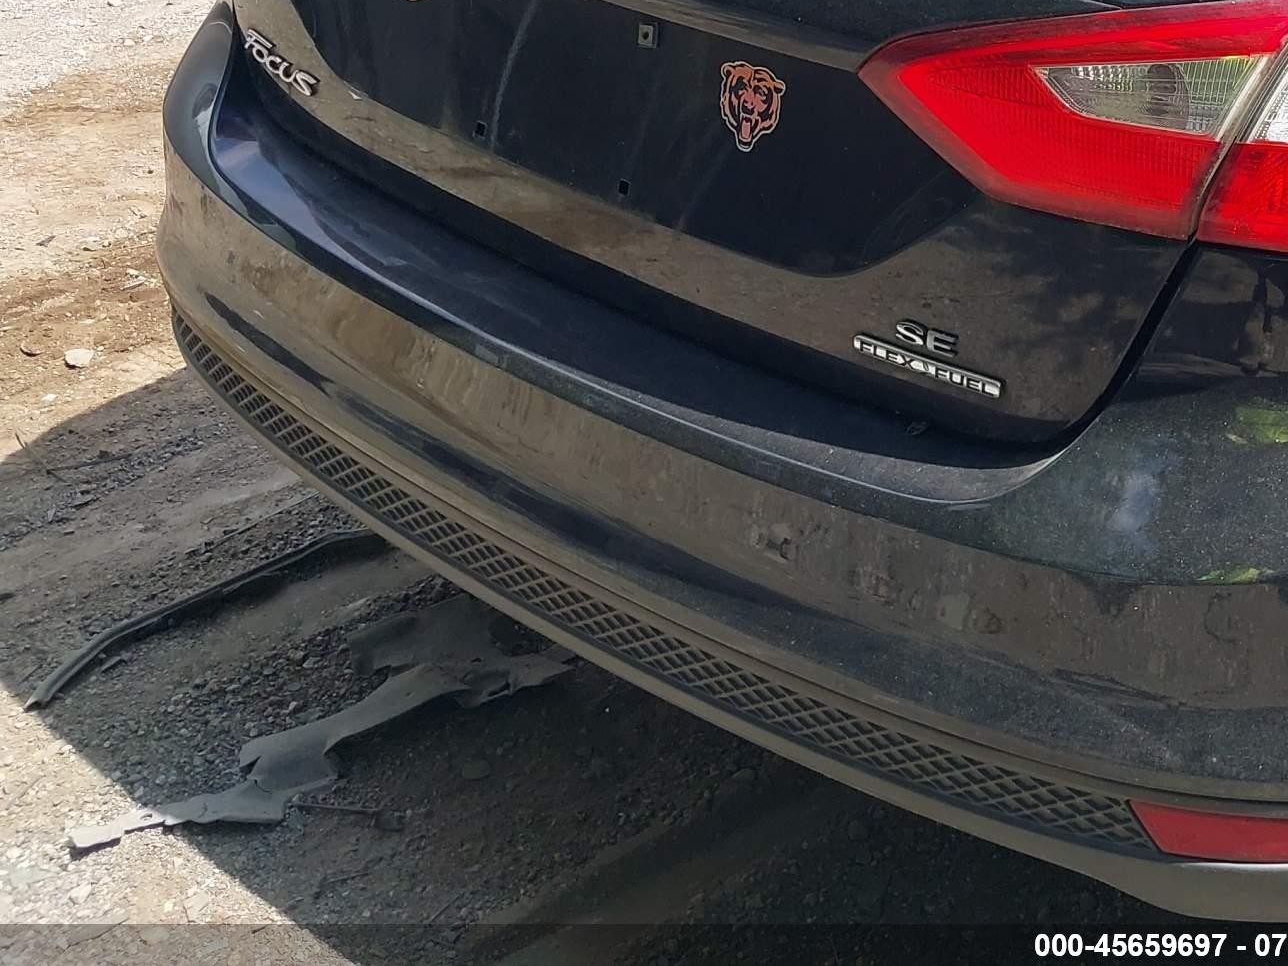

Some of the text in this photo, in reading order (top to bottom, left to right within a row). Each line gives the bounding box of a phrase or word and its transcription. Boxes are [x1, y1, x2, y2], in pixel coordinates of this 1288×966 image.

[895, 321, 959, 358] SE
[859, 341, 995, 397] FLEX FUEL
